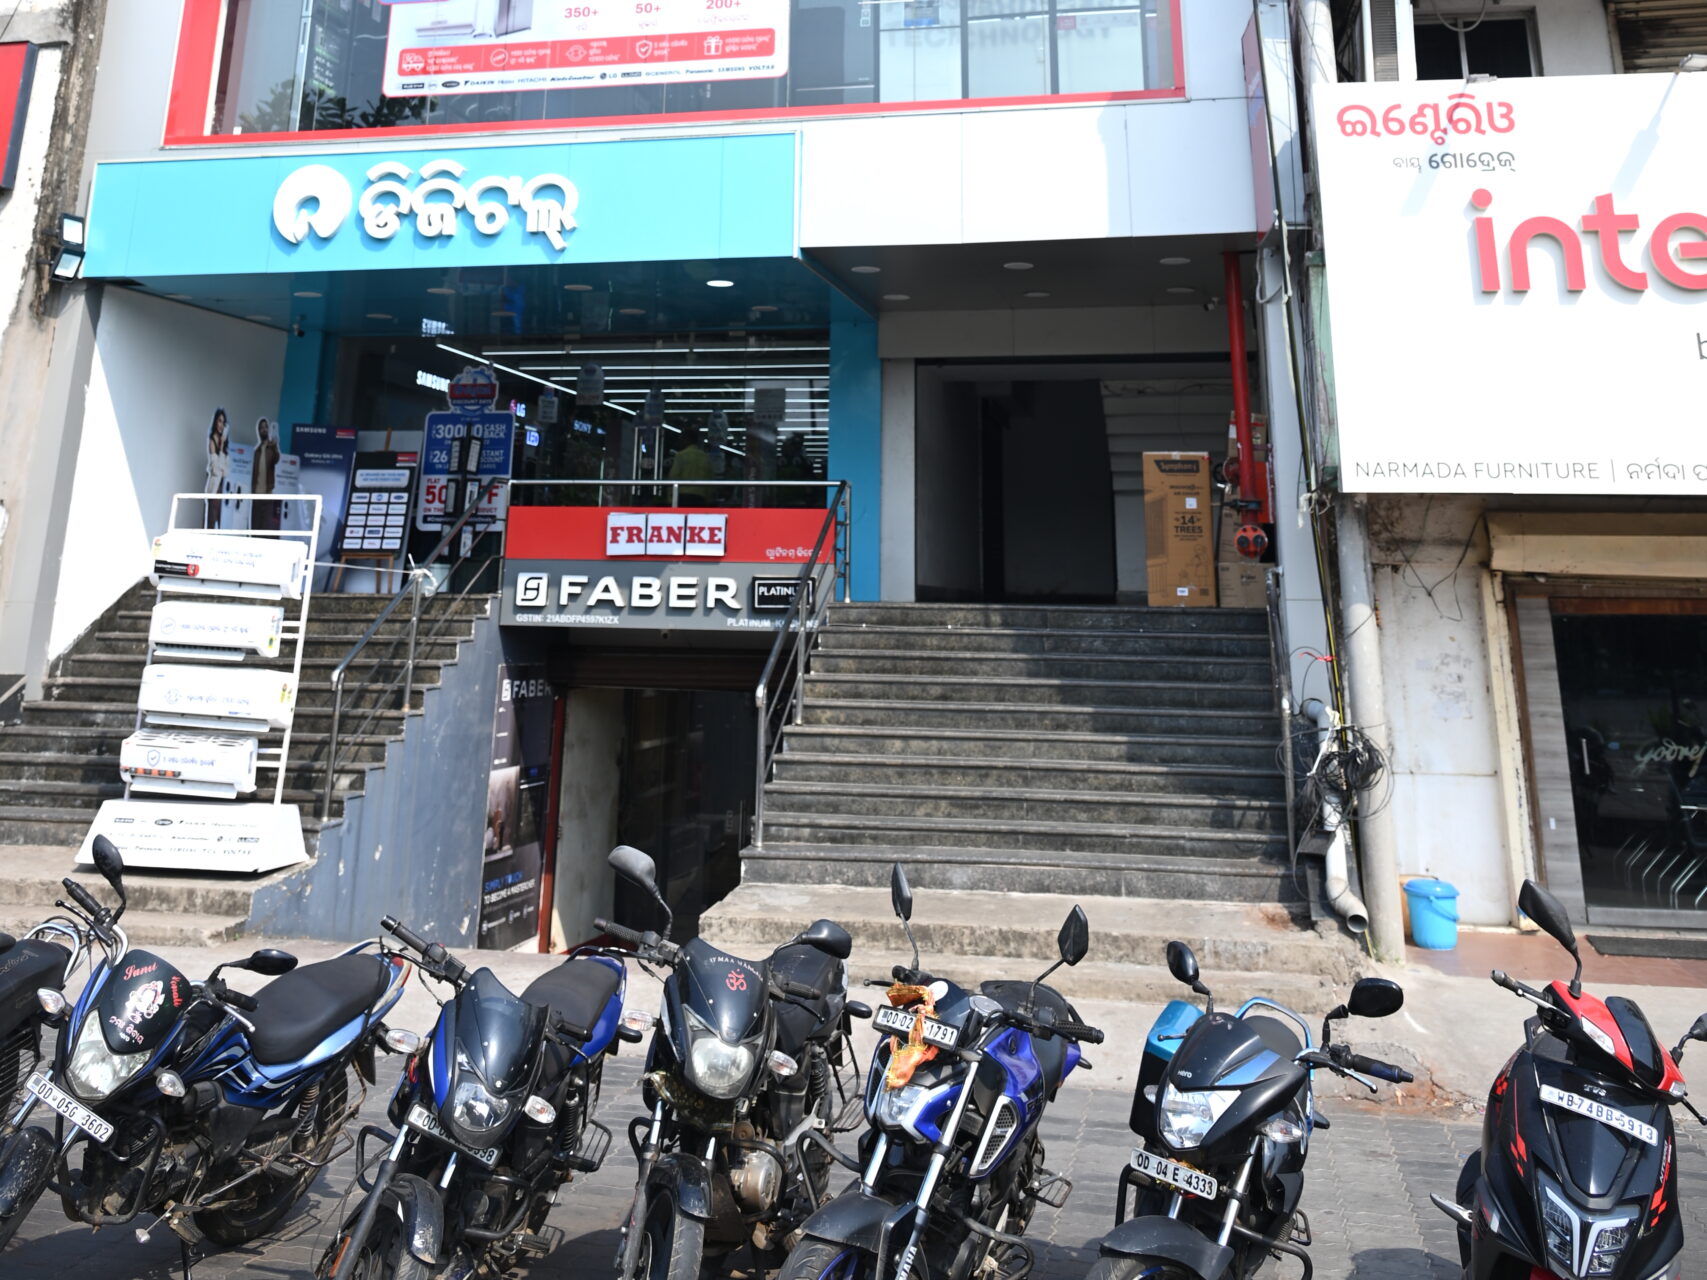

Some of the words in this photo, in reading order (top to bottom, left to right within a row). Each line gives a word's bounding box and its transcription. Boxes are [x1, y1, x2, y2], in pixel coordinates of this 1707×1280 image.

[564, 6, 599, 18] 350+
[635, 3, 662, 14] 50+
[1355, 461, 1467, 479] NARMADA
[1474, 462, 1600, 479] FURNITURE
[609, 525, 722, 545] FRANKE
[559, 575, 742, 609] FABER
[727, 618, 771, 628] PLATINUM
[1583, 1083, 1607, 1097] TVS
[81, 1114, 110, 1140] 3602
[1136, 1153, 1150, 1170] OD
[1185, 1173, 1213, 1196] 4333
